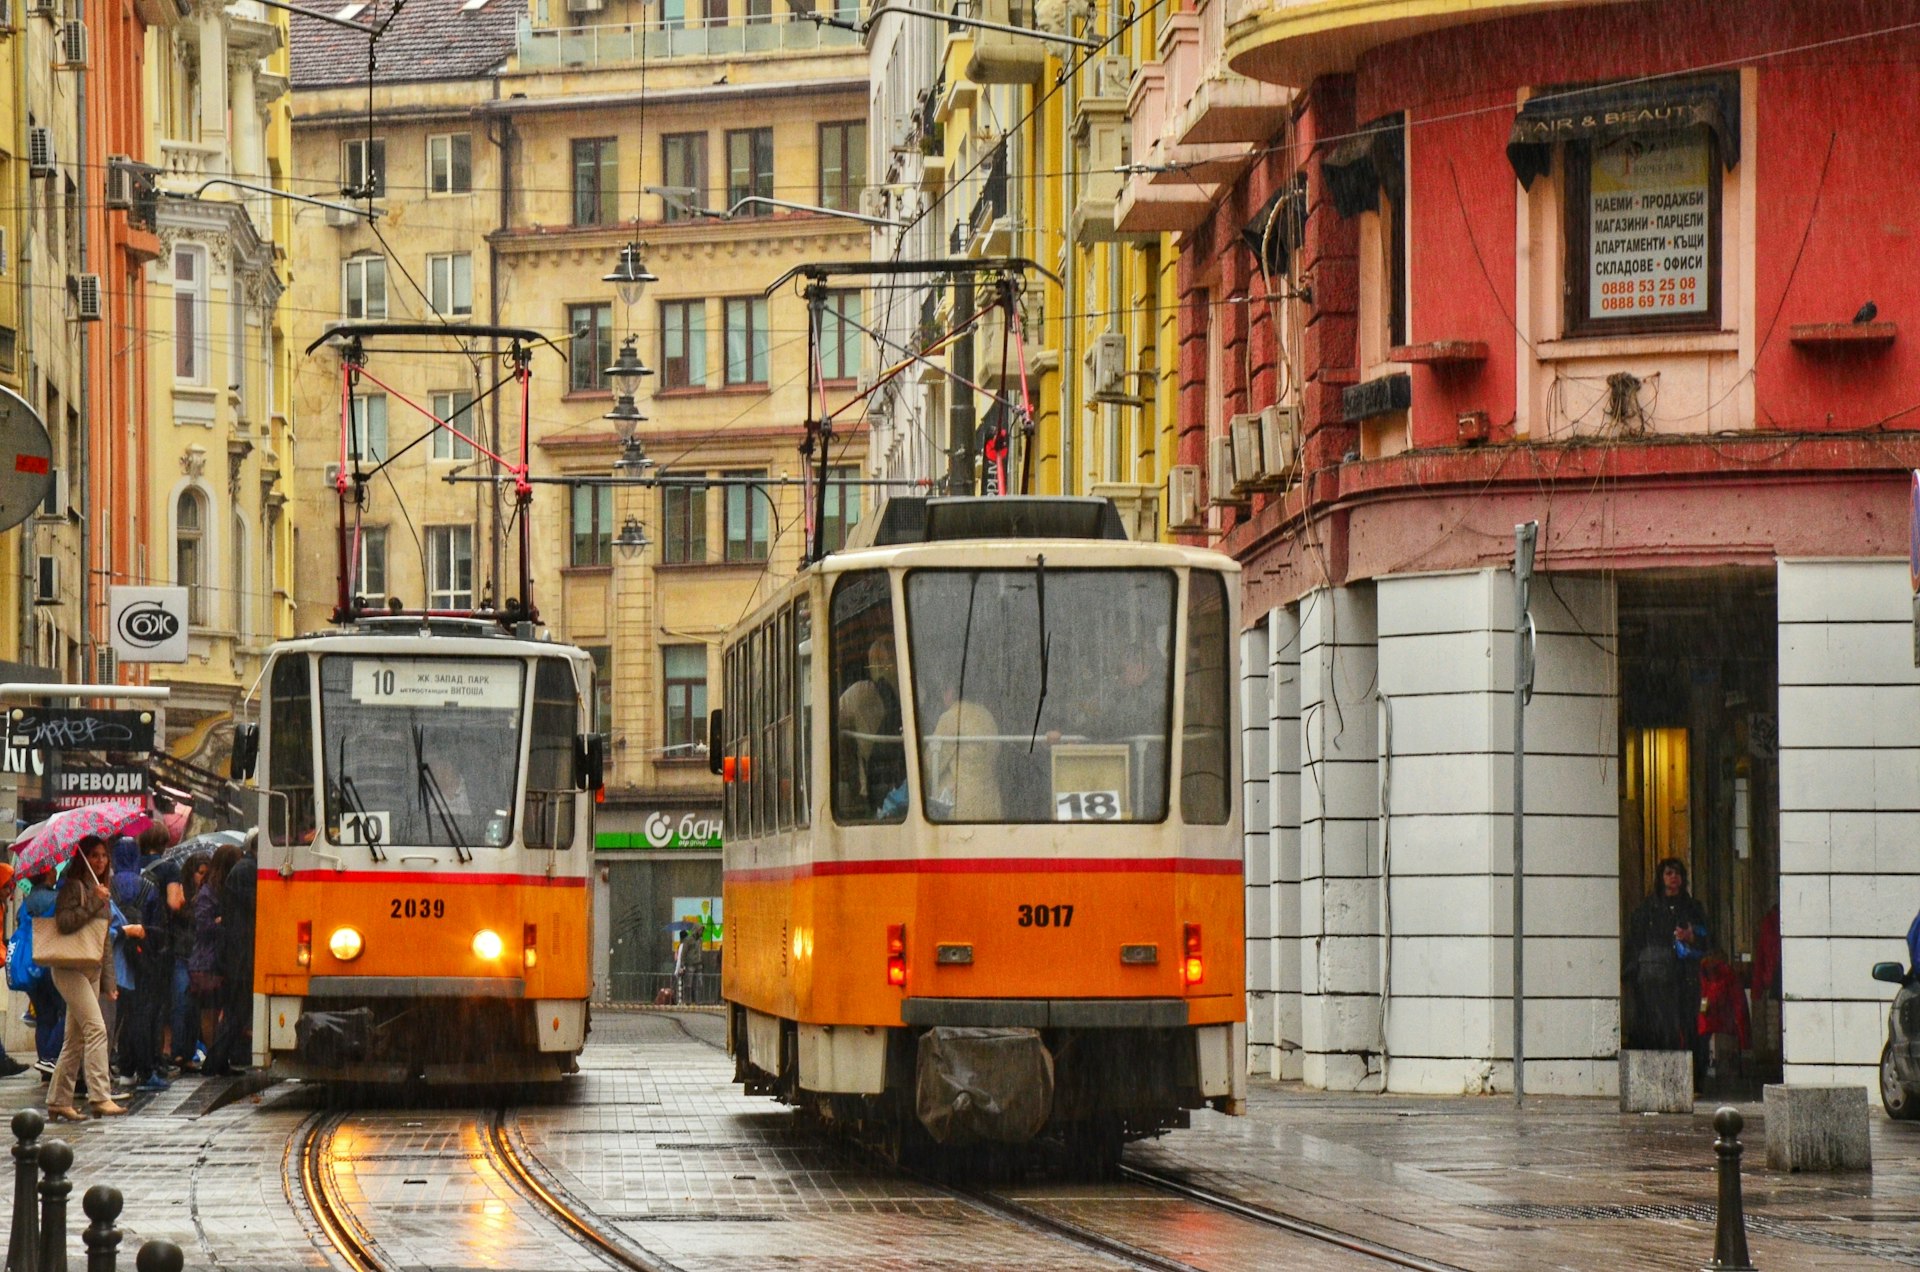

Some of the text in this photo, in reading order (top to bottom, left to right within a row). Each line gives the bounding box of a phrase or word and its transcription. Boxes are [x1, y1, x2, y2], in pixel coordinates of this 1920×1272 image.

[1604, 103, 1702, 125] BEAUTY
[1595, 191, 1704, 213] НАЕМИ ПРОДАЖБИ
[1595, 212, 1704, 234] МАГАЗИНИ ПАРЦЕЛИ
[1594, 233, 1704, 255] АПАРТАМЕНТИ КЪЩИ
[1595, 255, 1703, 276] СКЛАДОВЕ ОФИСИ
[1601, 276, 1696, 295] 0888 53 25 08
[1601, 292, 1696, 310] 0888 69 78 81
[372, 669, 395, 696] 10
[434, 674, 463, 684] ЗАПАД
[468, 675, 489, 684] ПАРК
[450, 686, 484, 696] ВИТОША
[1058, 793, 1117, 820] 18
[346, 814, 383, 844] 10
[390, 899, 445, 918] 2039
[1018, 905, 1074, 927] 3017
